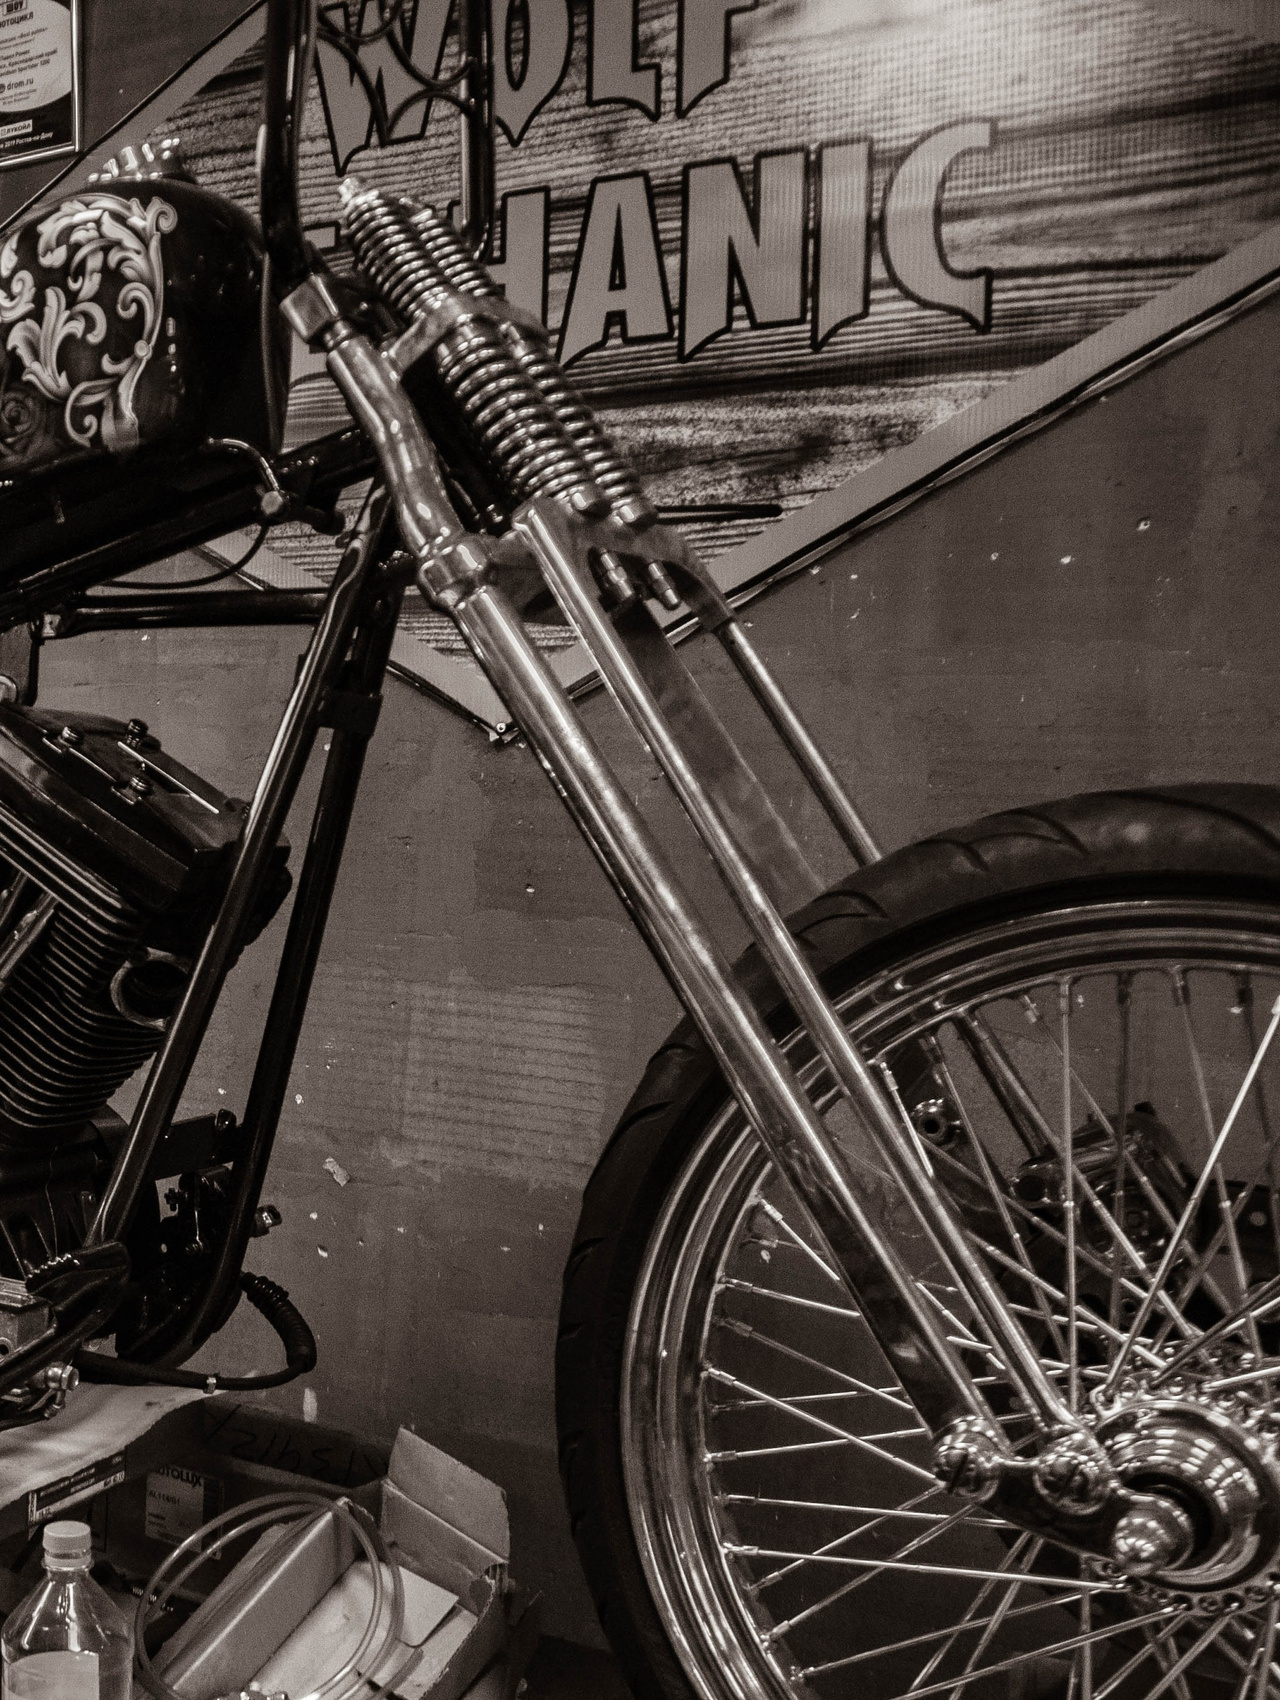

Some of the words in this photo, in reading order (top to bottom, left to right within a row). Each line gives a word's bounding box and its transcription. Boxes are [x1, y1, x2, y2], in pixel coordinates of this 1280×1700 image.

[7, 78, 34, 91] drom.ru
[314, 0, 759, 176] WOLF
[6, 122, 31, 134] ЛУКОЙЛ
[447, 118, 999, 369] HANIC
[155, 1467, 202, 1488] UTOLUX
